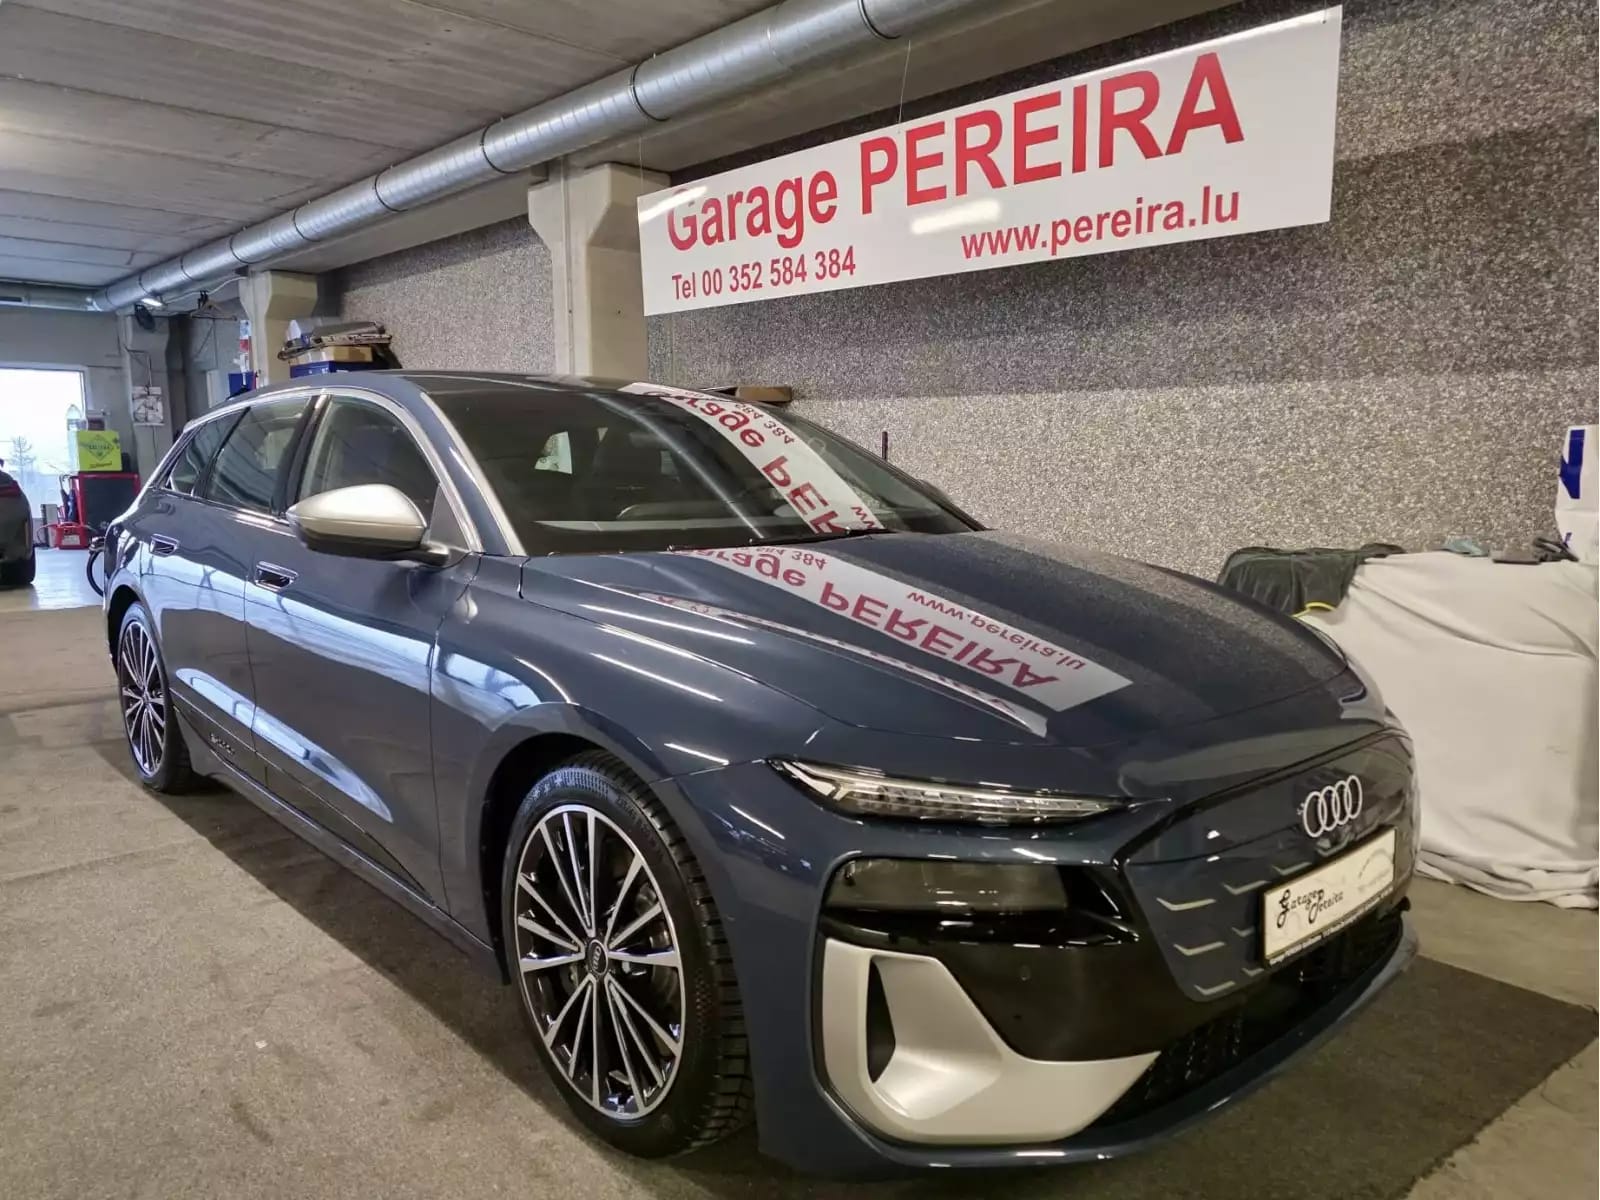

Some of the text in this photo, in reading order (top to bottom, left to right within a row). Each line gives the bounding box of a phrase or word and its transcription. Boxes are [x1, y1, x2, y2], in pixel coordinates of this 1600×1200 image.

[666, 51, 1245, 252] Garage PEREIRA
[961, 185, 1240, 260] www.pereira.lu
[671, 247, 857, 301] Tel 00 352 584 384
